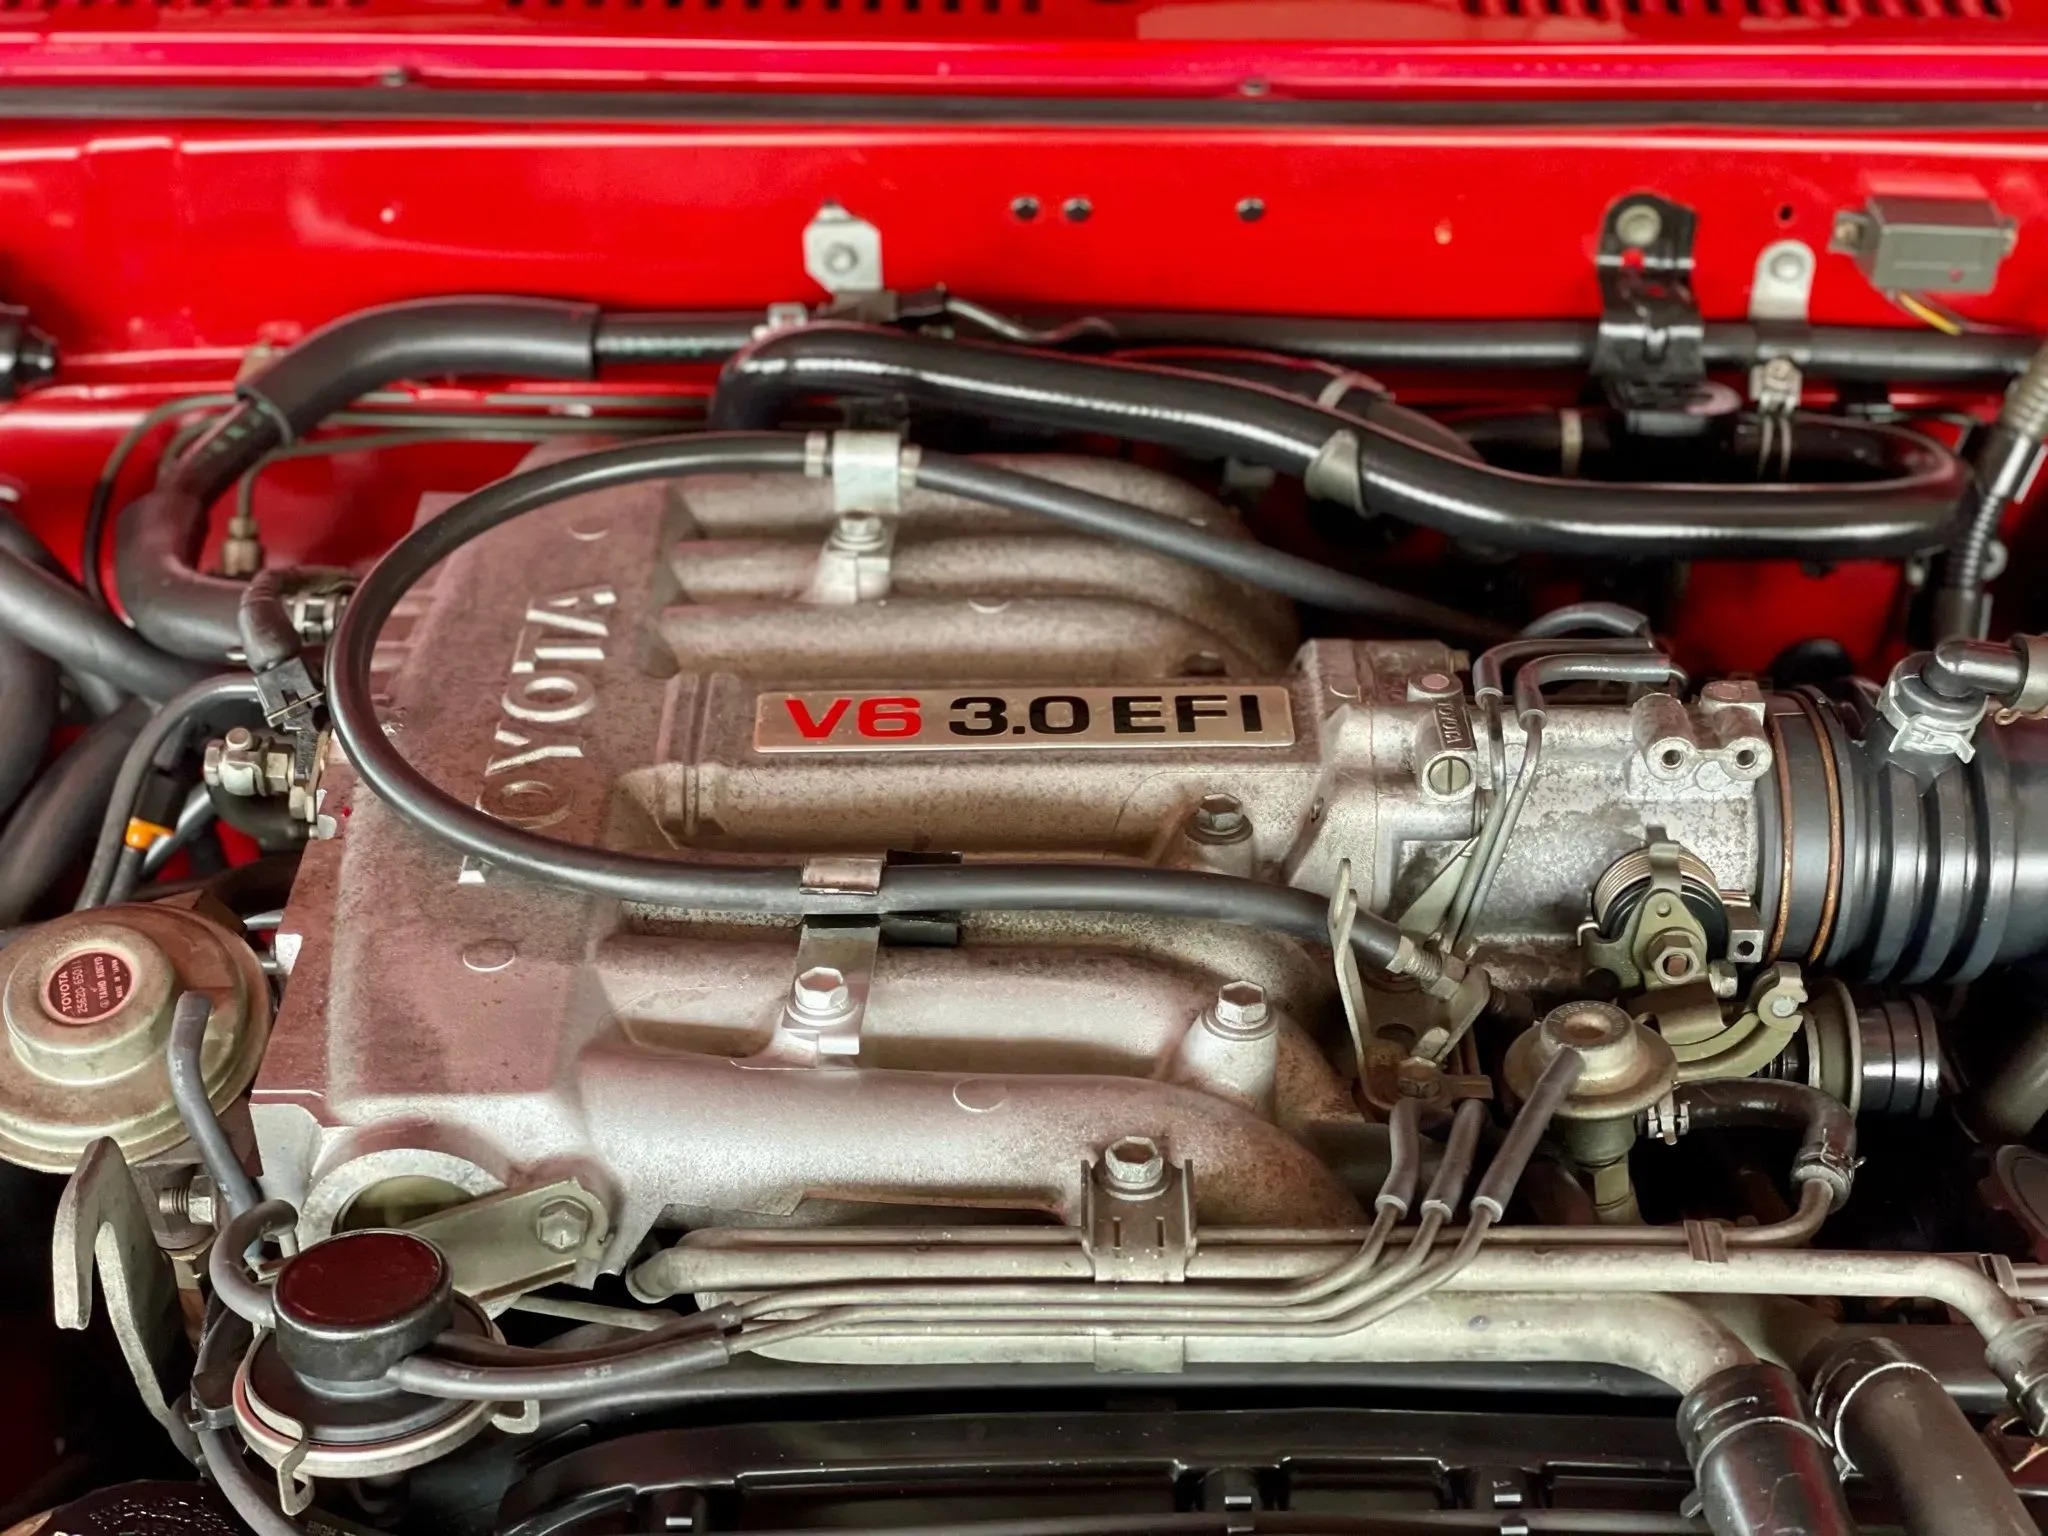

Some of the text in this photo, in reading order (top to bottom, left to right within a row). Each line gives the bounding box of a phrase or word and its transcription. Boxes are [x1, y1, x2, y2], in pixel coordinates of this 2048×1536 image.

[784, 694, 1264, 739] V6 3.0 EFI
[58, 970, 73, 1012] TOYOTA
